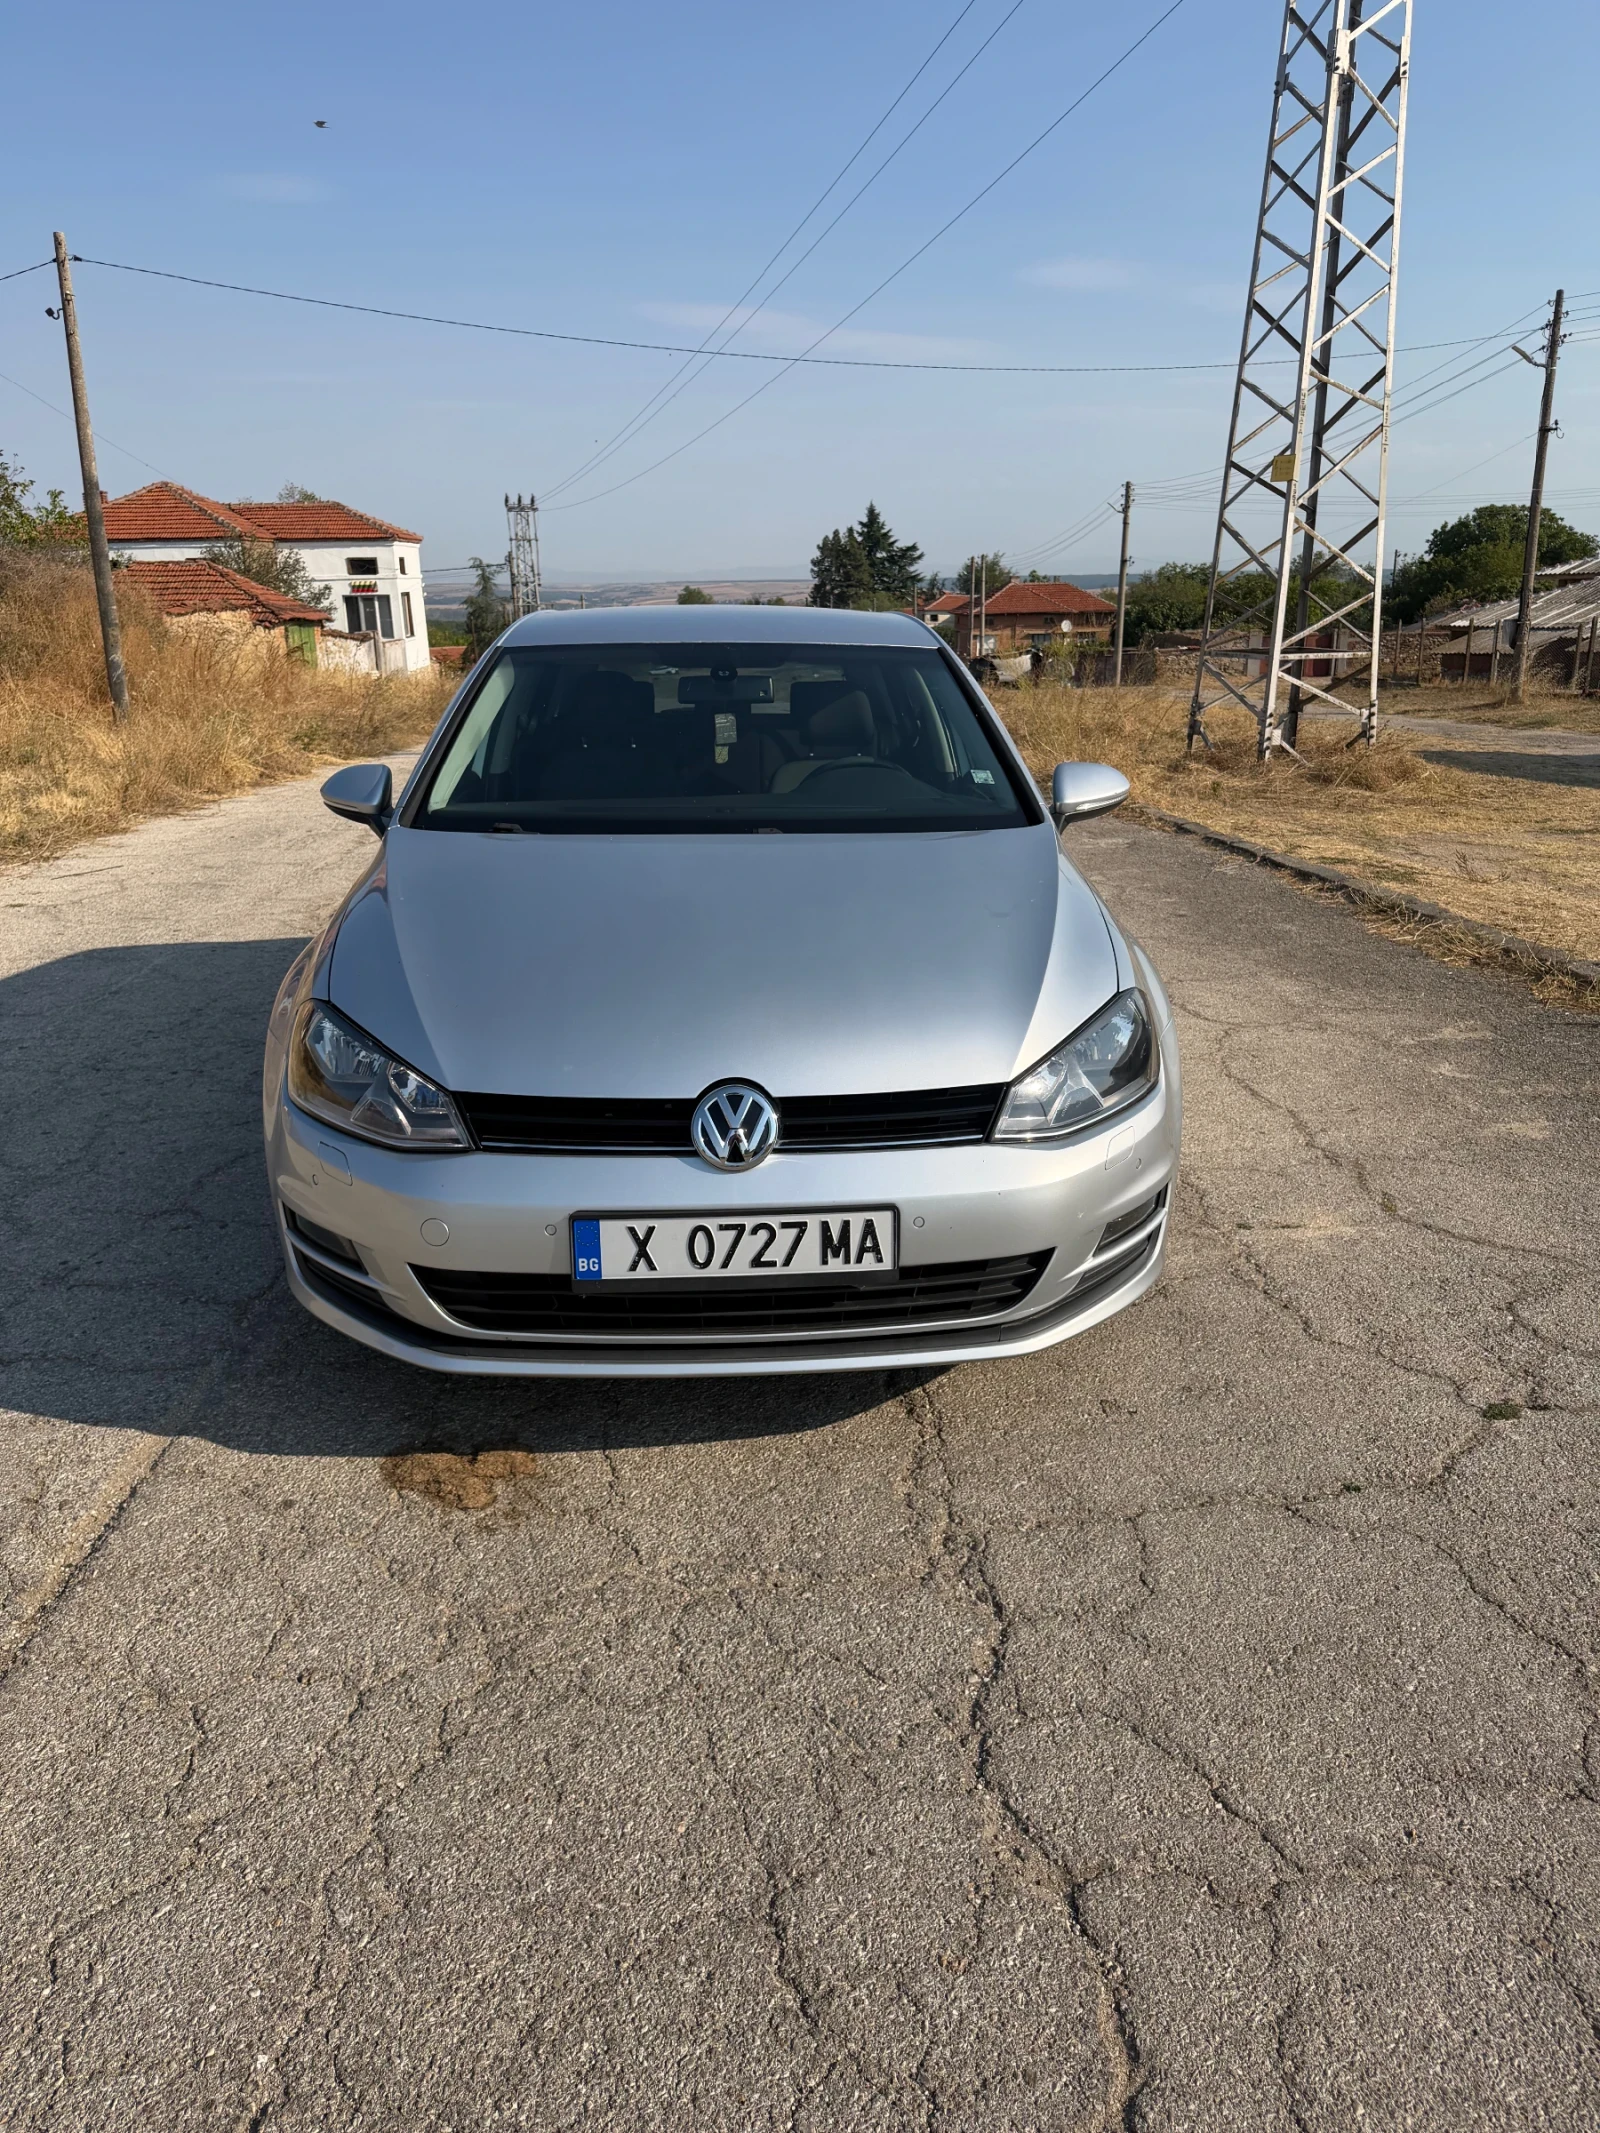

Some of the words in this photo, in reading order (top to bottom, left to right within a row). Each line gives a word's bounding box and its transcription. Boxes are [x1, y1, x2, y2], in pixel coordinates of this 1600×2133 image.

[696, 1089, 774, 1166] VW
[578, 1257, 599, 1272] BG
[626, 1225, 659, 1272] X
[687, 1220, 809, 1270] 0727
[820, 1218, 885, 1266] MA
